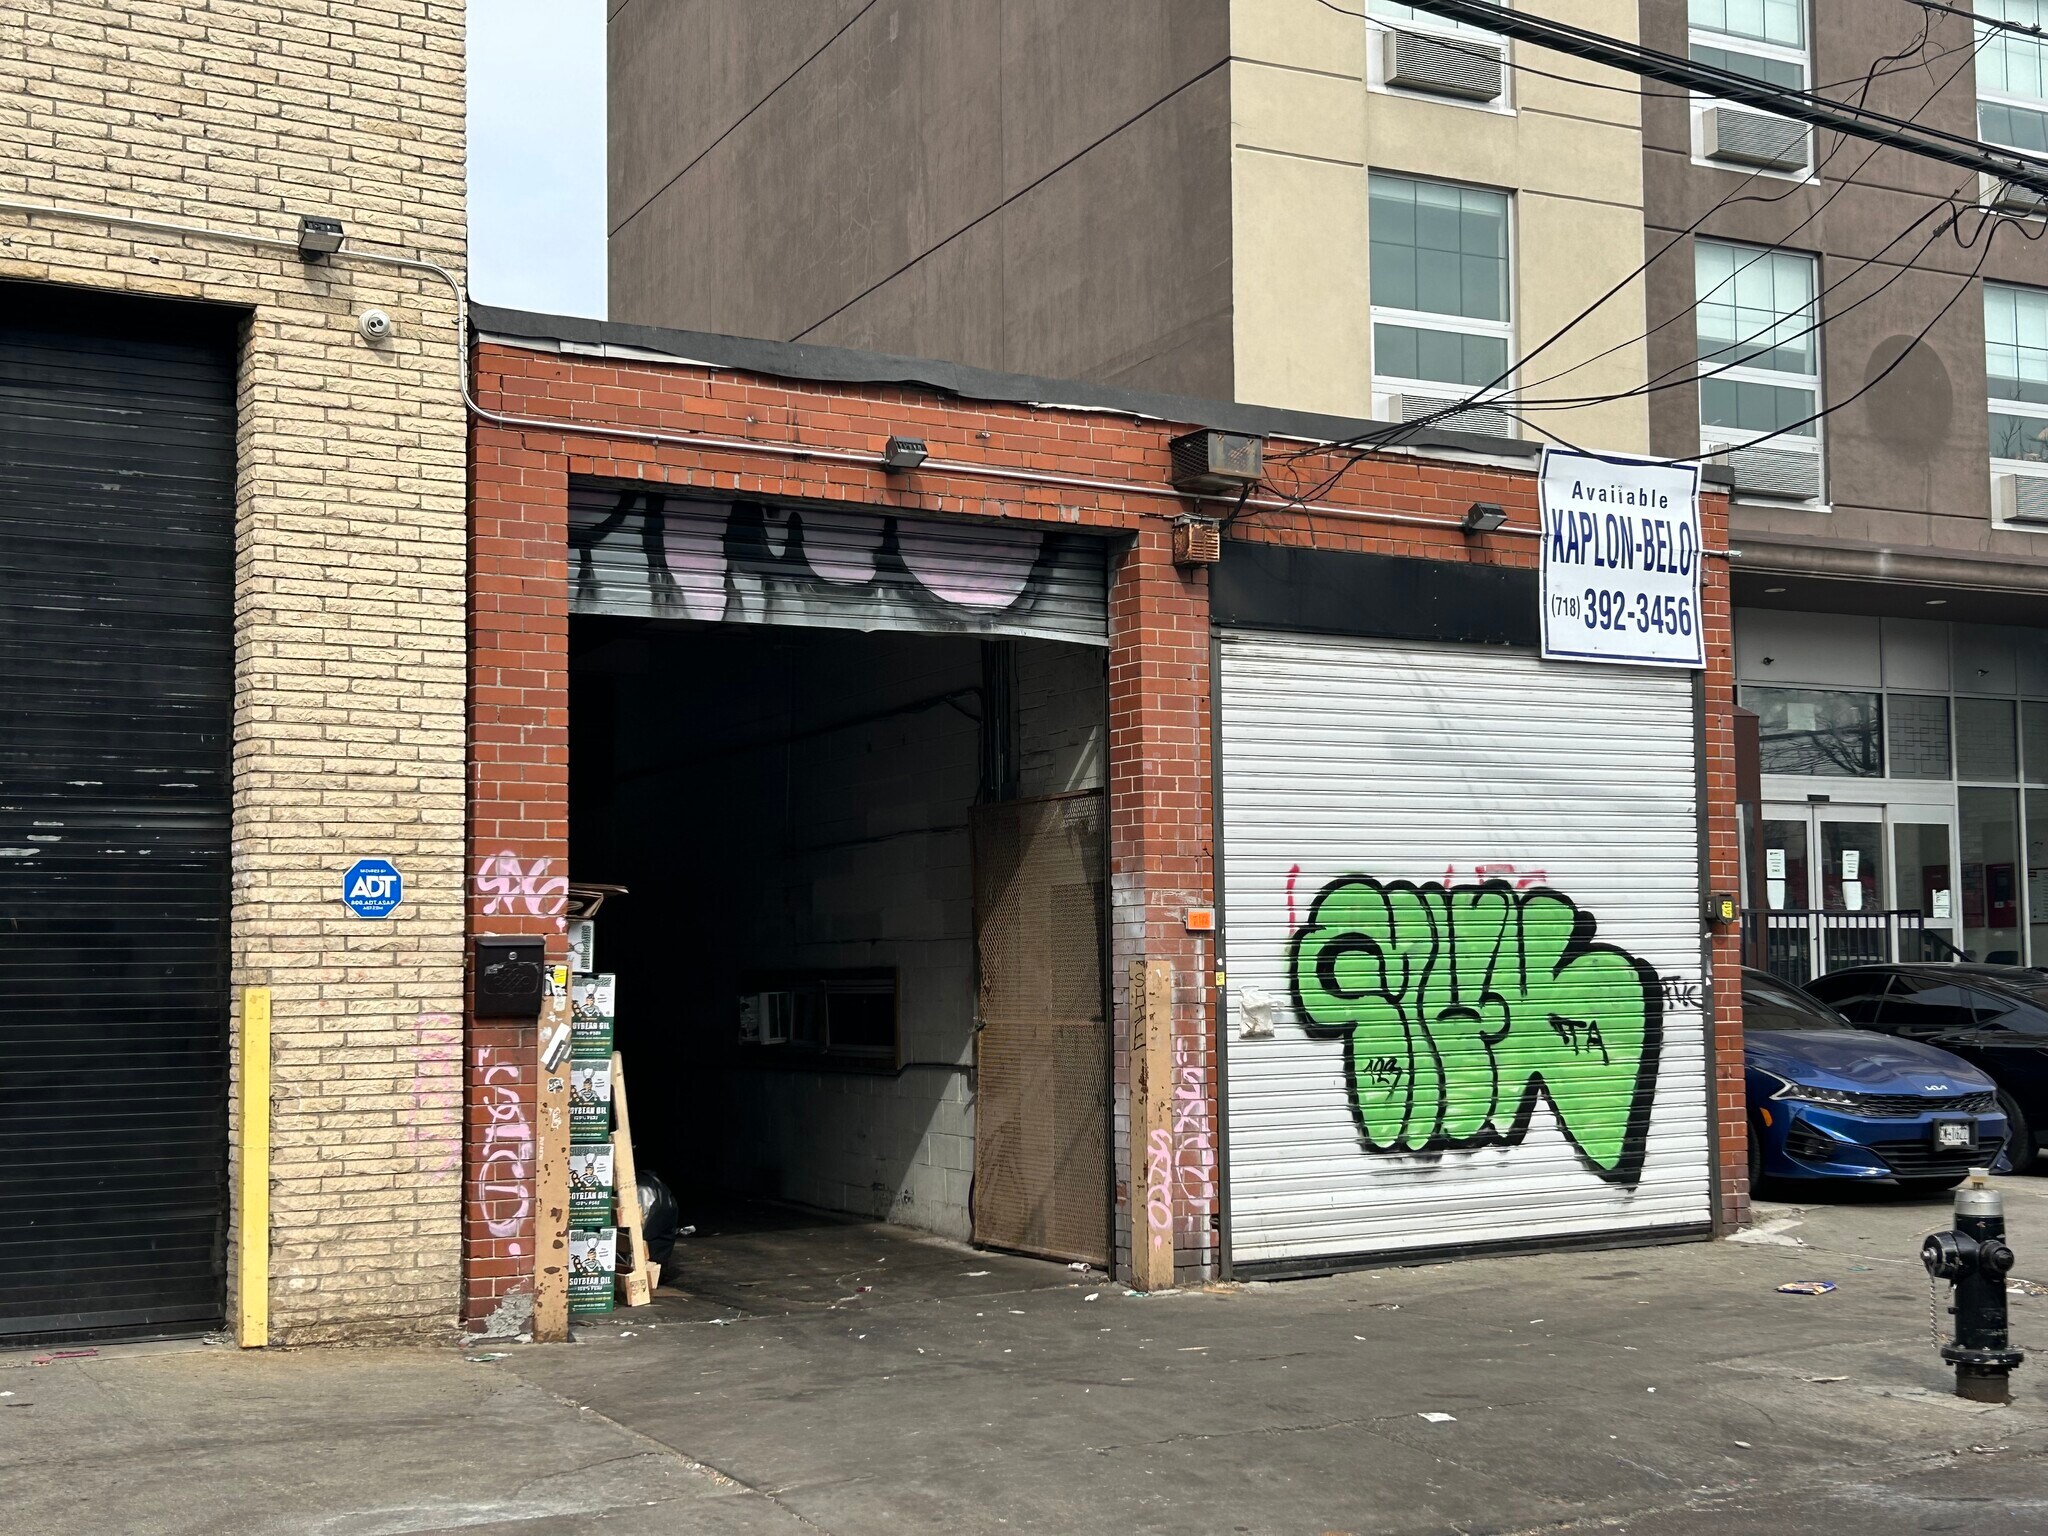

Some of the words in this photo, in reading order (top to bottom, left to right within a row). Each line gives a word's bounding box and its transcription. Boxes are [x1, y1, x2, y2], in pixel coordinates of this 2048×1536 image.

[1551, 508, 1692, 576] KAPLON-BELO
[1552, 593, 1580, 619] (718)
[1584, 588, 1692, 636] 392-3456
[349, 876, 397, 898] ADT
